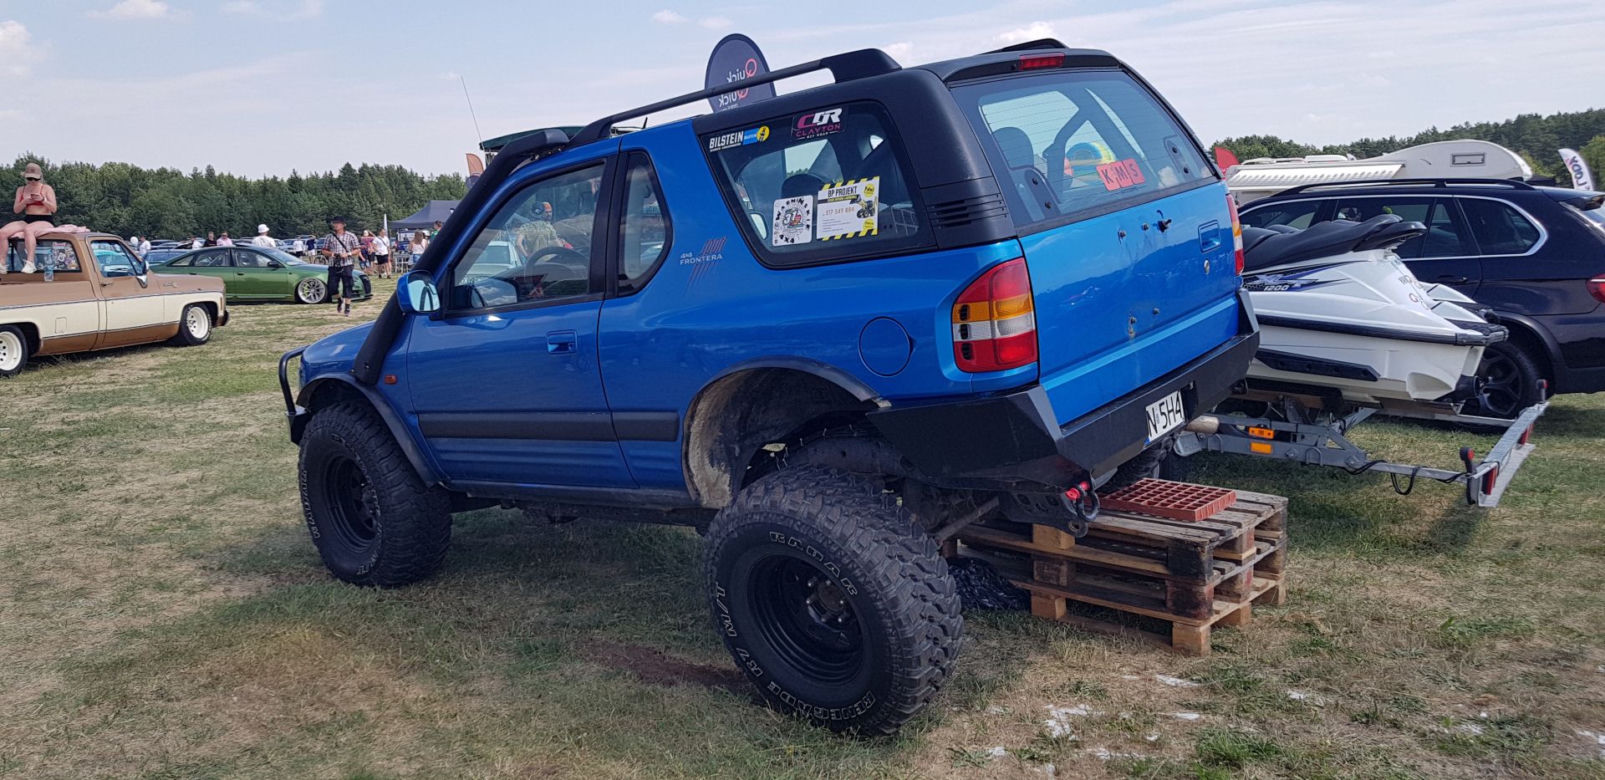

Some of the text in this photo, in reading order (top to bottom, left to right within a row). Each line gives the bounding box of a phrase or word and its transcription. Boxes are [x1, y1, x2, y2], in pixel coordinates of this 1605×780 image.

[795, 123, 841, 137] CLAYTON
[709, 131, 744, 149] BILSTEIN
[827, 189, 835, 198] BP
[836, 186, 857, 196] PROJEKT
[680, 254, 723, 265] FRONTERA
[767, 681, 876, 721] RENEGADE
